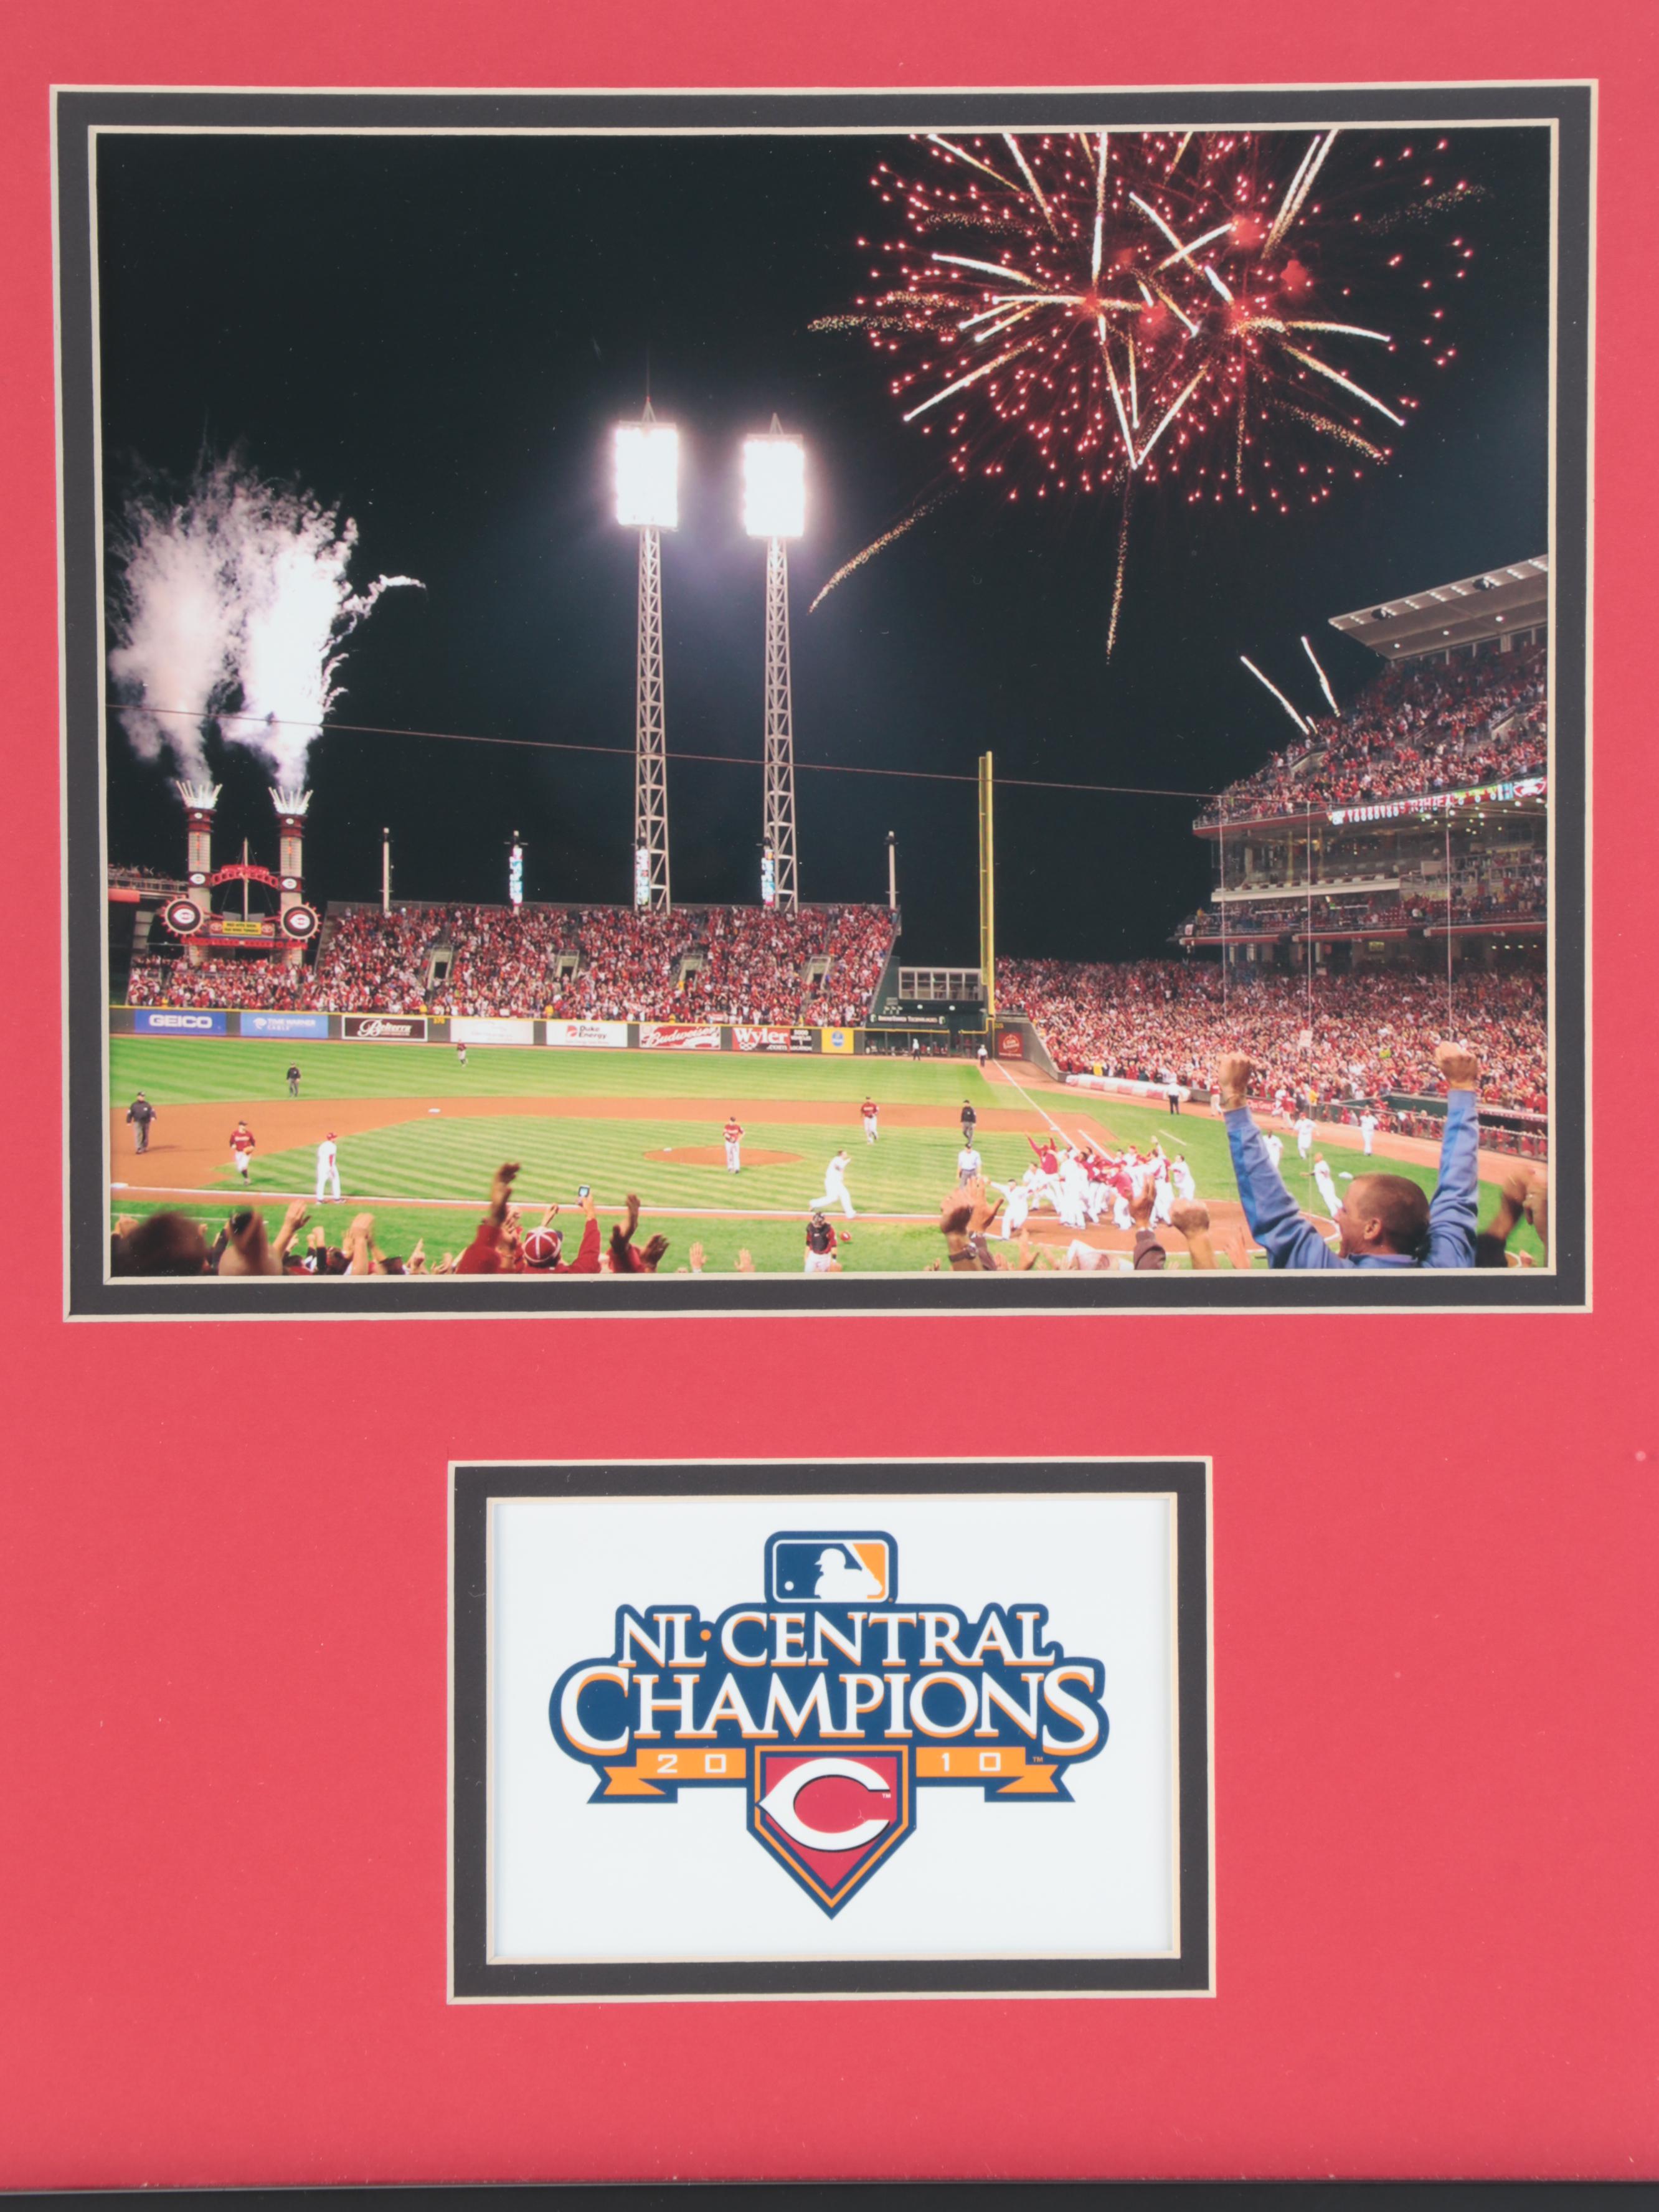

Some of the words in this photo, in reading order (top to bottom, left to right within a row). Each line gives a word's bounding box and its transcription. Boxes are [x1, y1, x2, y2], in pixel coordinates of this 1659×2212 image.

[149, 1014, 212, 1029] GEICO
[648, 1026, 719, 1047] Budweiser
[732, 1027, 789, 1048] Wyler
[560, 1665, 1099, 1756] CHAMPIONS
